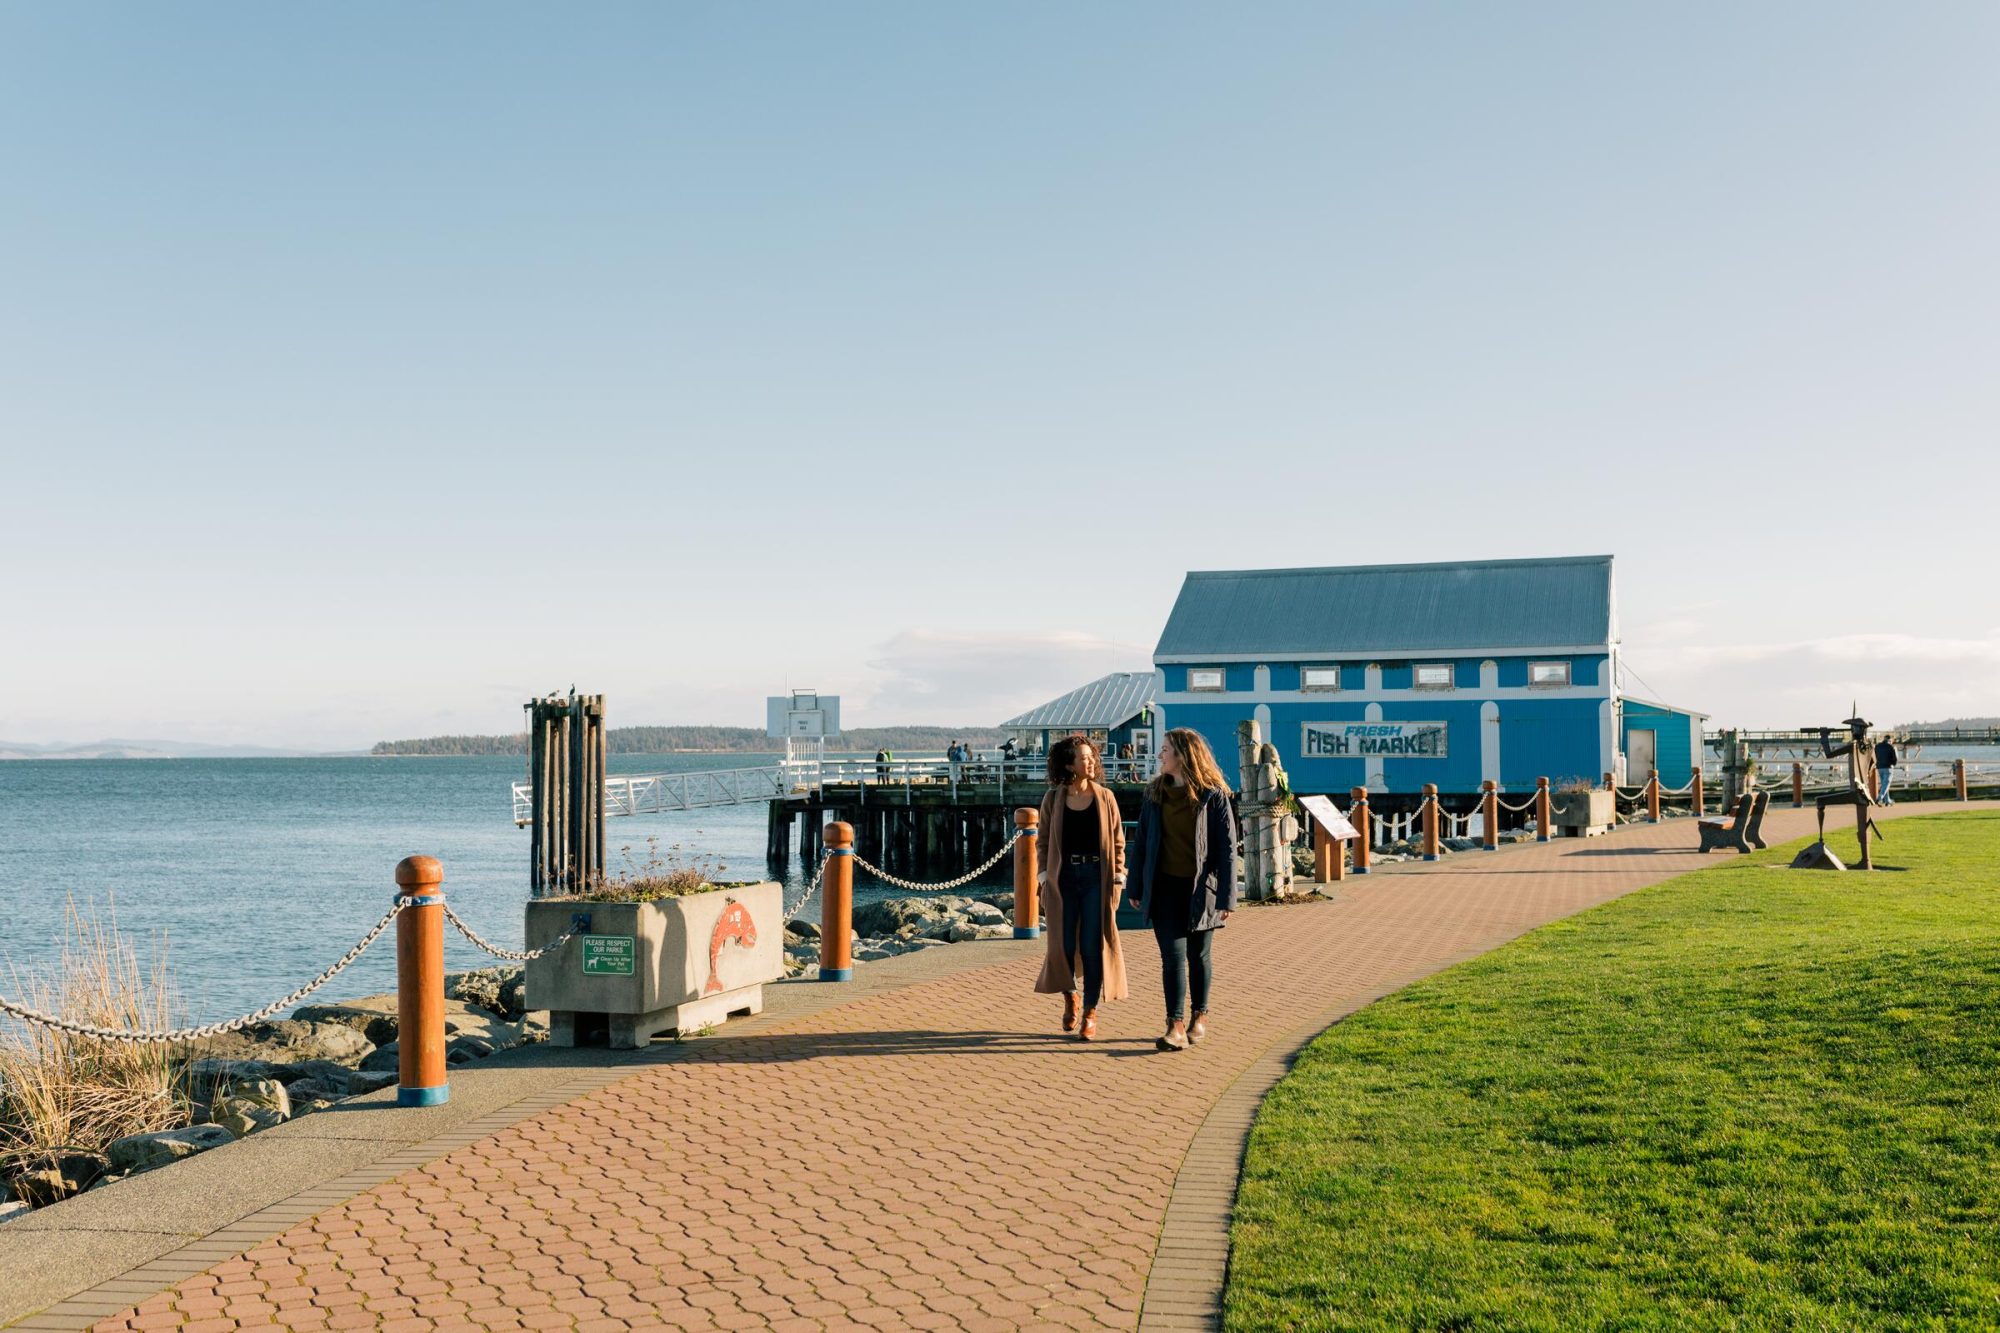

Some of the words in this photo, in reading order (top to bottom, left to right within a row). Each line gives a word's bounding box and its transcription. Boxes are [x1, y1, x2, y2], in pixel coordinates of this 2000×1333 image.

[1344, 725, 1403, 736] FRESH
[1307, 728, 1349, 754] FISH
[1359, 729, 1441, 755] MARKET
[607, 939, 631, 947] RESPECT
